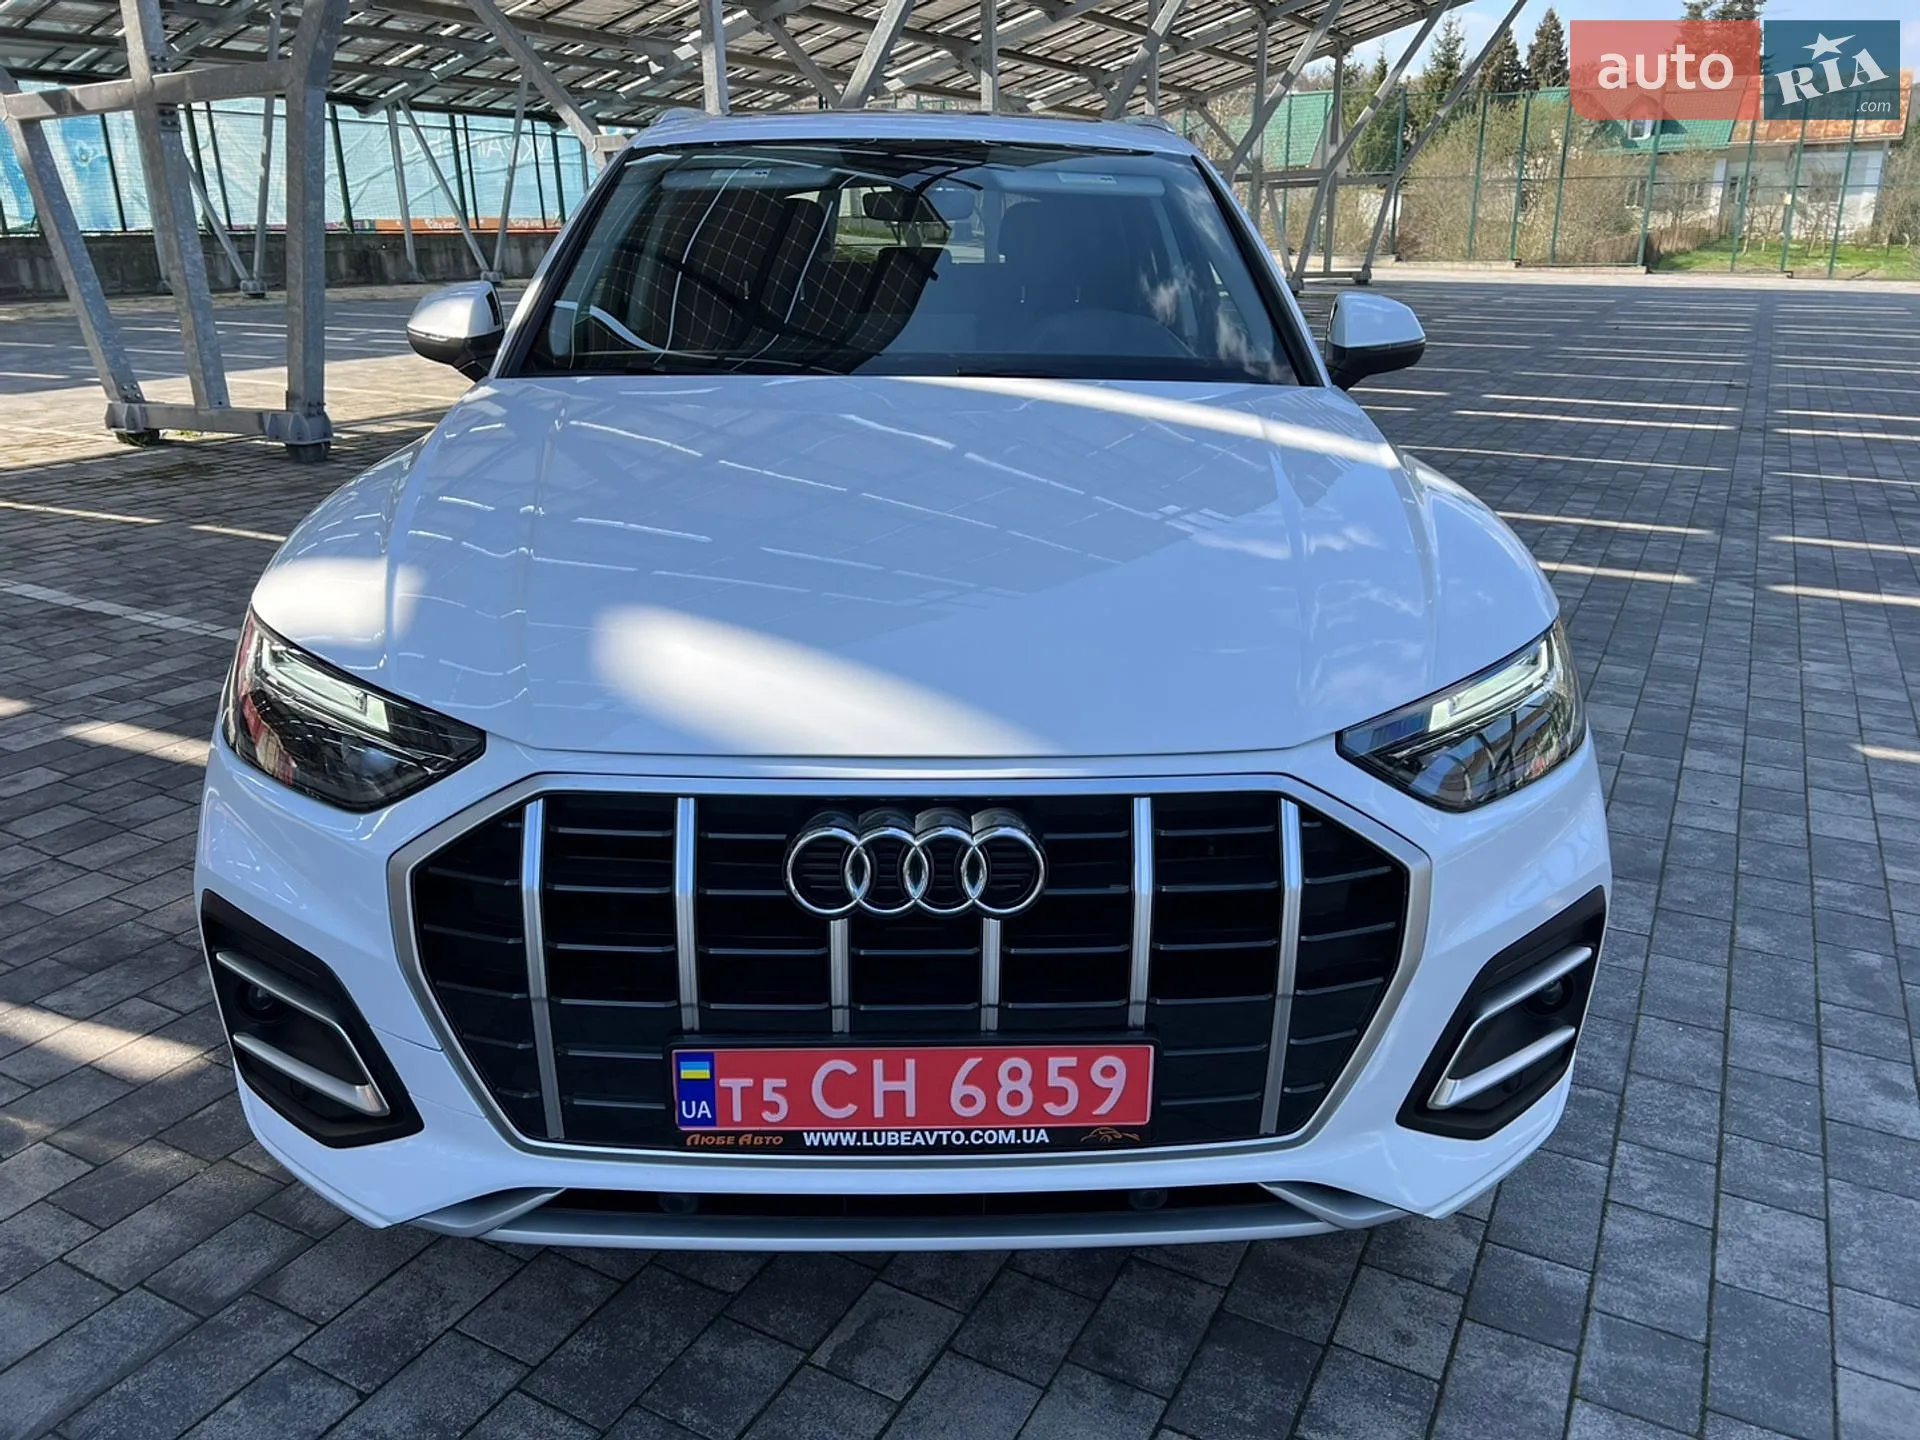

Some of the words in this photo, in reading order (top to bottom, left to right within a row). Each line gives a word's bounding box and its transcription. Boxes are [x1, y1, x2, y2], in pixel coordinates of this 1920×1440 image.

[719, 1077, 789, 1123] T5
[811, 1058, 917, 1119] CH
[949, 1055, 1127, 1118] 6859
[681, 1100, 712, 1120] UA
[803, 1128, 1050, 1147] WWW.LUBEAVTO.COM.UA
